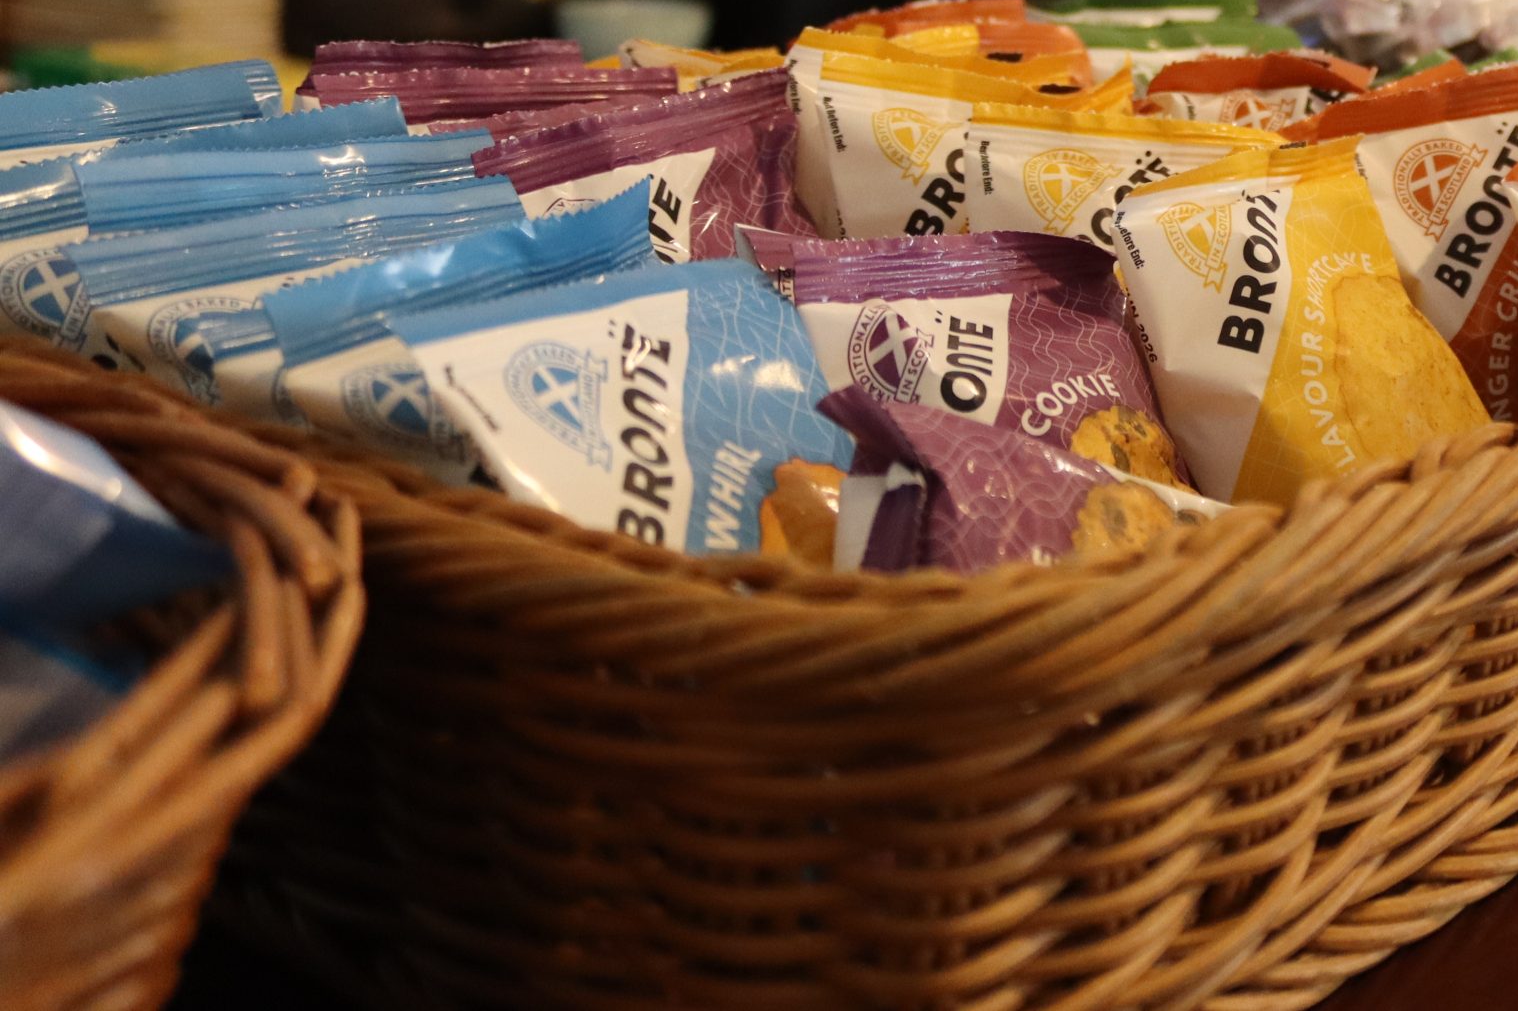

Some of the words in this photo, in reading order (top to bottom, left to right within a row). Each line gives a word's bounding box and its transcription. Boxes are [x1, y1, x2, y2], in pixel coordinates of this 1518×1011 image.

[1396, 144, 1426, 223] TRADITIONALLY
[1425, 141, 1464, 154] BAKED
[1442, 156, 1472, 207] SCOTLAND
[1130, 248, 1146, 270] End:
[1136, 323, 1158, 363] 2026
[900, 379, 913, 396] IN
[1021, 373, 1121, 437] COOKIE
[704, 440, 763, 550] WHIRL
